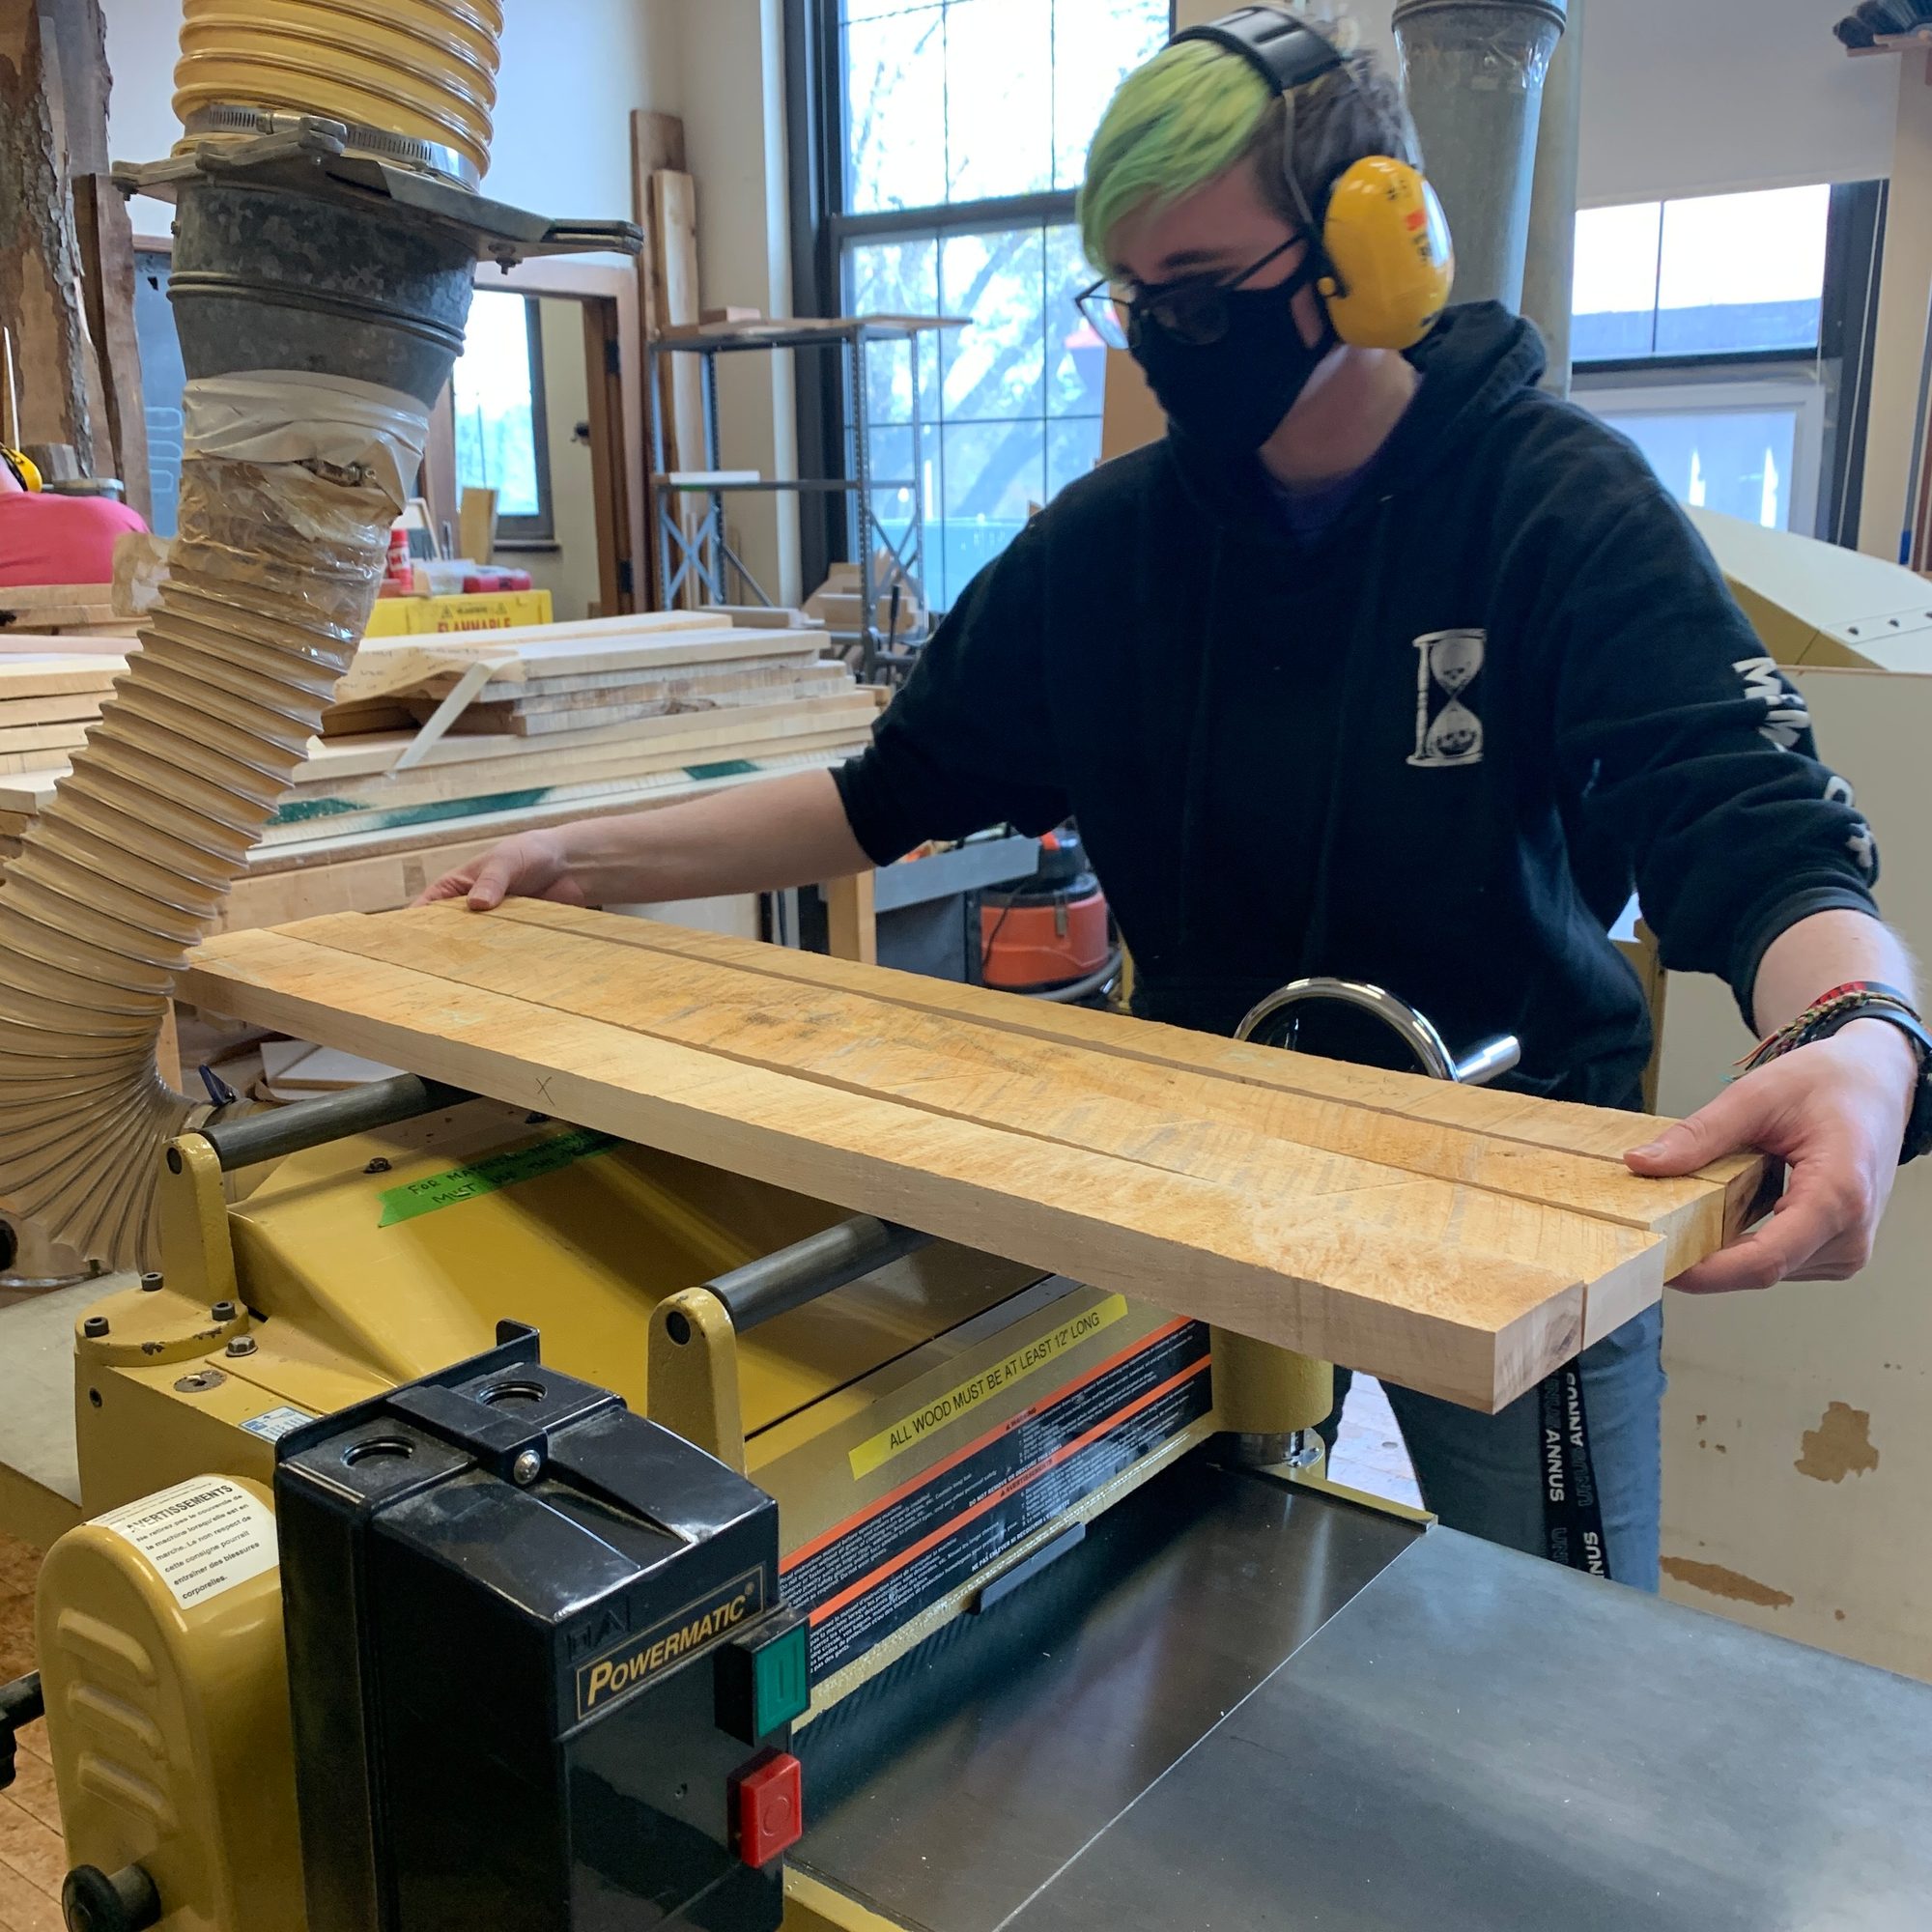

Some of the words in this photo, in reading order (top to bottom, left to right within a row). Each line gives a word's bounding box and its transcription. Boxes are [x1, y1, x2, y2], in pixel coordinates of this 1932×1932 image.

[407, 1178, 441, 1196] FOR
[432, 1182, 476, 1206] MUST
[890, 1426, 912, 1449] ALL
[913, 1401, 952, 1434] WOOD
[952, 1383, 985, 1411] MUST
[987, 1368, 1003, 1391] BE
[1005, 1359, 1018, 1380] AT
[1020, 1341, 1052, 1370] LEAST
[1069, 1312, 1100, 1339] LONG
[1545, 1429, 1565, 1502] ANNUS
[968, 1497, 976, 1508] DO
[976, 1490, 987, 1502] NOT
[986, 1477, 1007, 1495] REMOVE
[1007, 1472, 1014, 1483] OR
[127, 1485, 233, 1534] AVERTISSEMENTS
[199, 1531, 213, 1542] non
[214, 1520, 242, 1538] respect
[165, 1561, 185, 1573] cette
[185, 1546, 219, 1563] consigne
[220, 1530, 250, 1548] pourrait
[209, 1559, 223, 1570] des
[224, 1542, 260, 1561] blessures
[979, 1553, 988, 1567] PAS
[1583, 1531, 1605, 1578] NUS
[183, 1576, 228, 1600] corporelles.
